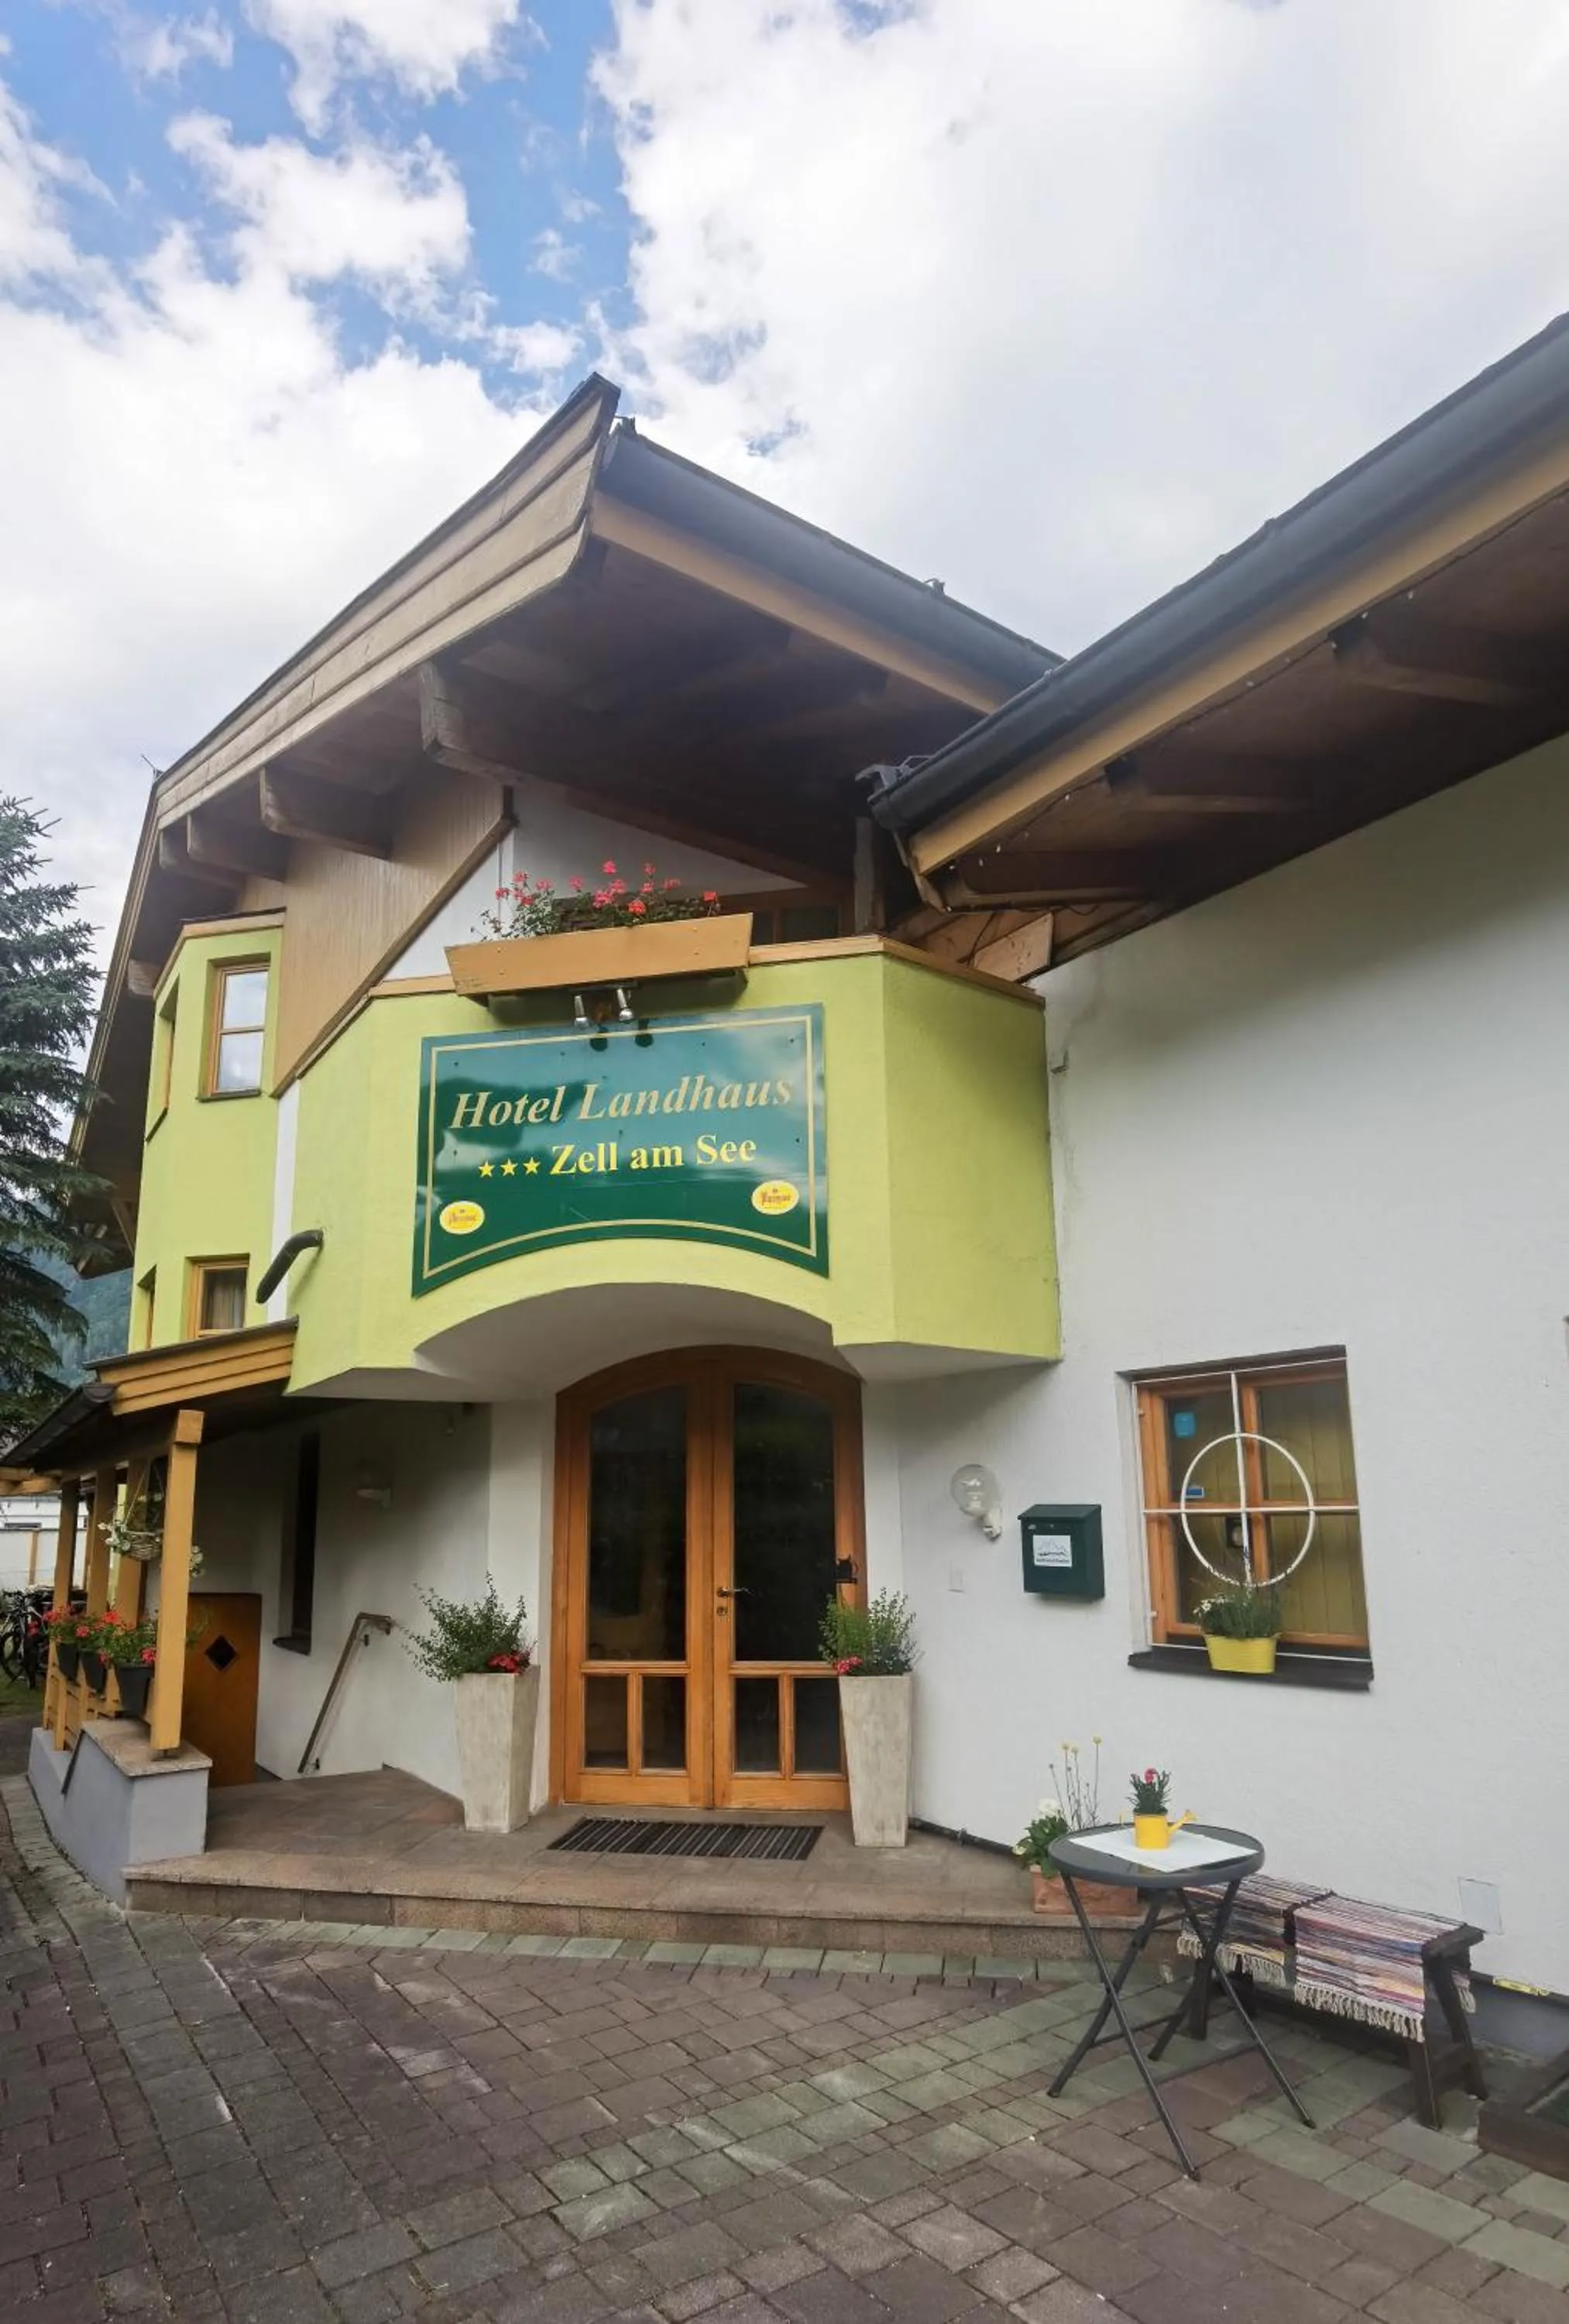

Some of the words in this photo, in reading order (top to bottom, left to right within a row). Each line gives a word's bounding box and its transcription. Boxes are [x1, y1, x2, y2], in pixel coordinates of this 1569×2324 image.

[448, 1085, 566, 1129] Hotel
[577, 1074, 792, 1120] Landhaus
[549, 1141, 619, 1175] Zell
[630, 1144, 685, 1170] am
[695, 1133, 757, 1165] See
